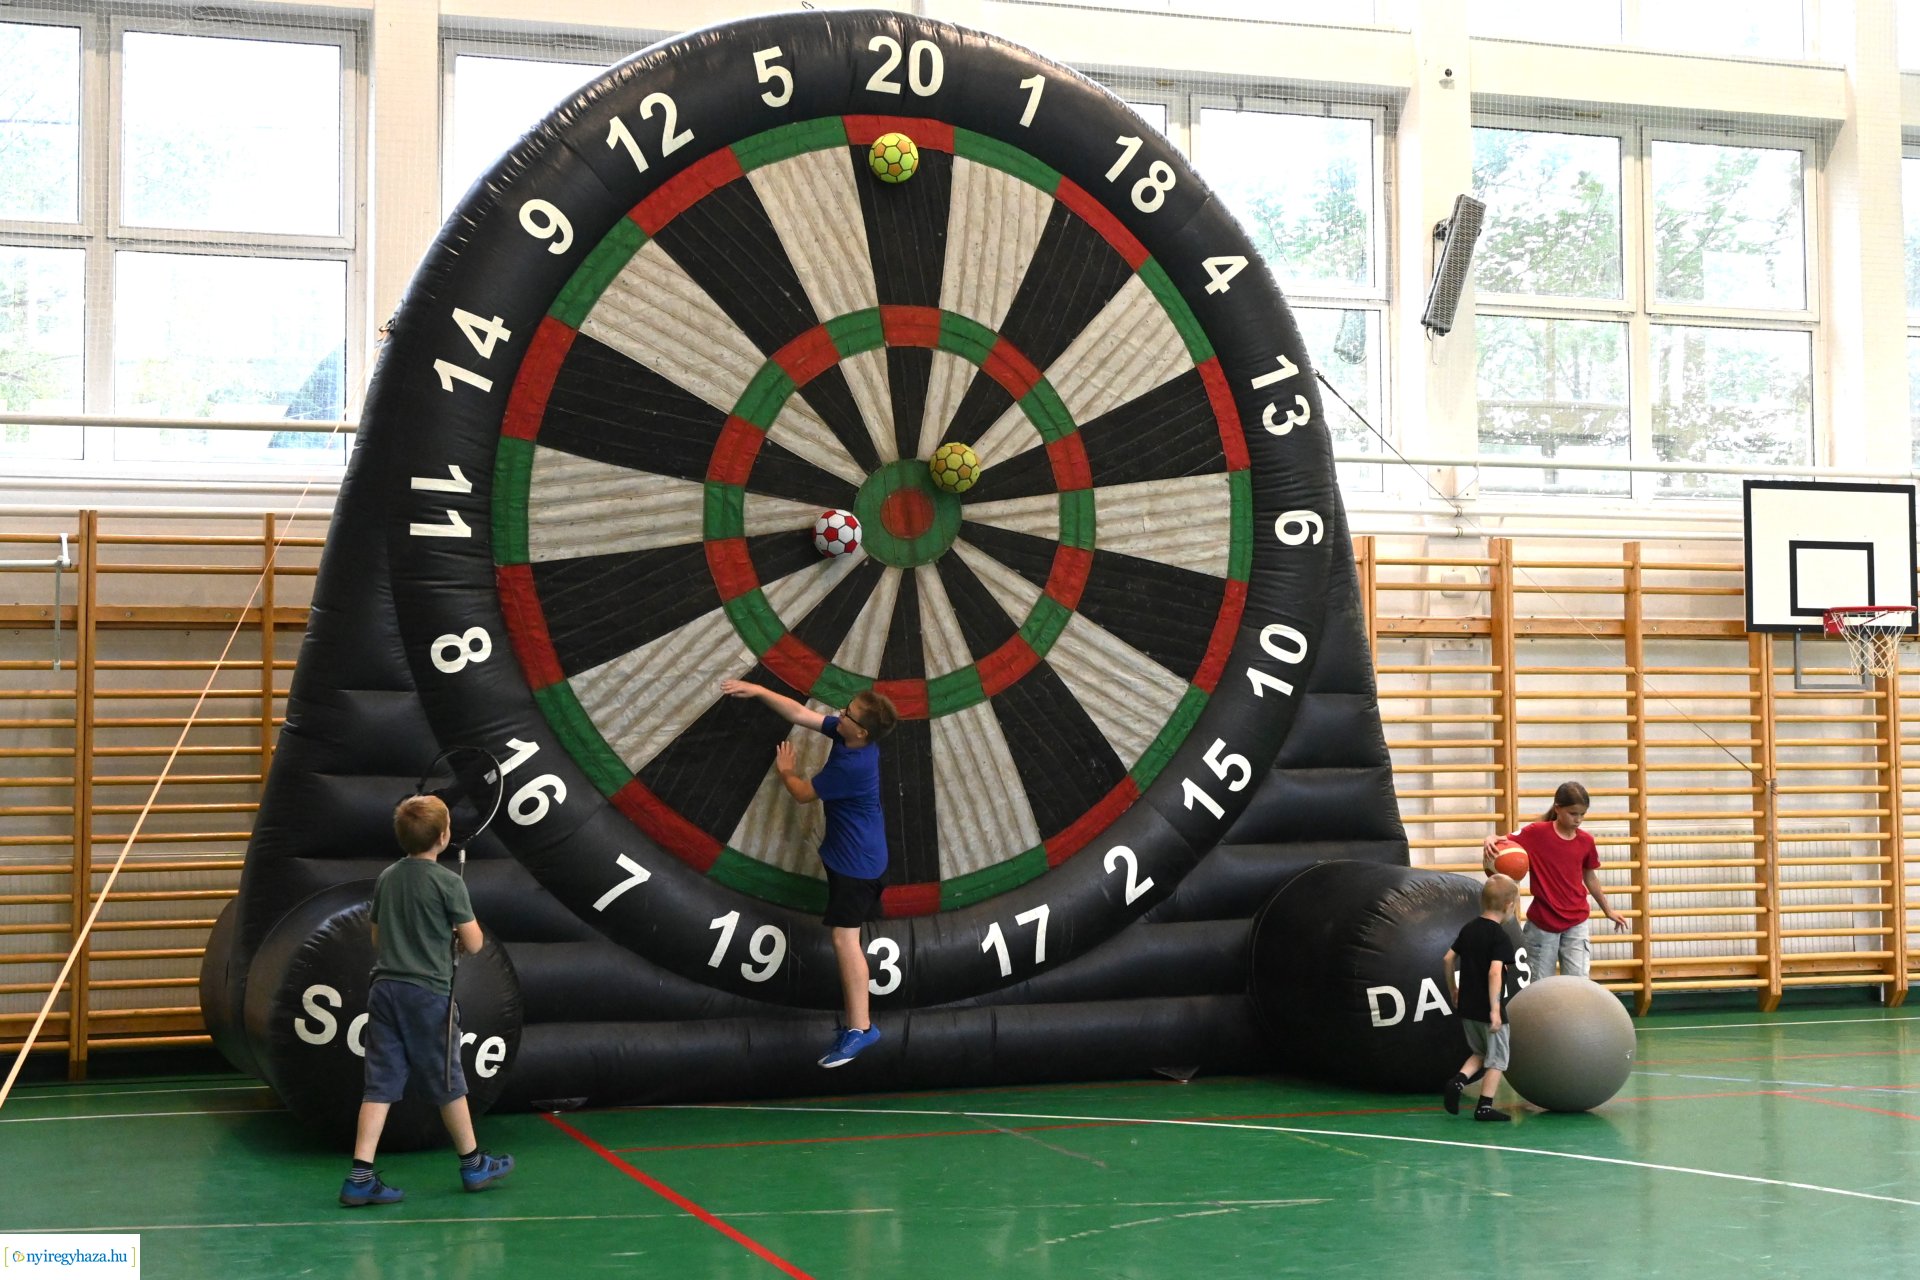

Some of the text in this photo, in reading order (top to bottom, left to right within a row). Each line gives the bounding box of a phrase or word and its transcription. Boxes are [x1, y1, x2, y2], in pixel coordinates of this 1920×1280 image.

[752, 45, 794, 108] 5
[865, 35, 944, 97] 20
[1019, 73, 1046, 128] 1
[605, 92, 695, 173] 12
[1104, 135, 1177, 214] 18
[518, 198, 574, 255] 9
[1201, 255, 1249, 295] 4
[433, 307, 512, 393] 14
[1251, 354, 1311, 436] 13
[410, 464, 473, 538] 11
[1274, 509, 1324, 546] 6
[430, 626, 493, 674] 8
[1246, 623, 1308, 698] 10
[483, 737, 567, 826] 16
[1182, 737, 1252, 820] 15
[592, 853, 652, 912] 7
[1103, 845, 1155, 906] 2
[708, 910, 786, 982] 19
[866, 937, 902, 995] 3
[981, 903, 1051, 977] 17
[1366, 947, 1532, 1028] DAS
[294, 984, 507, 1079] Scre
